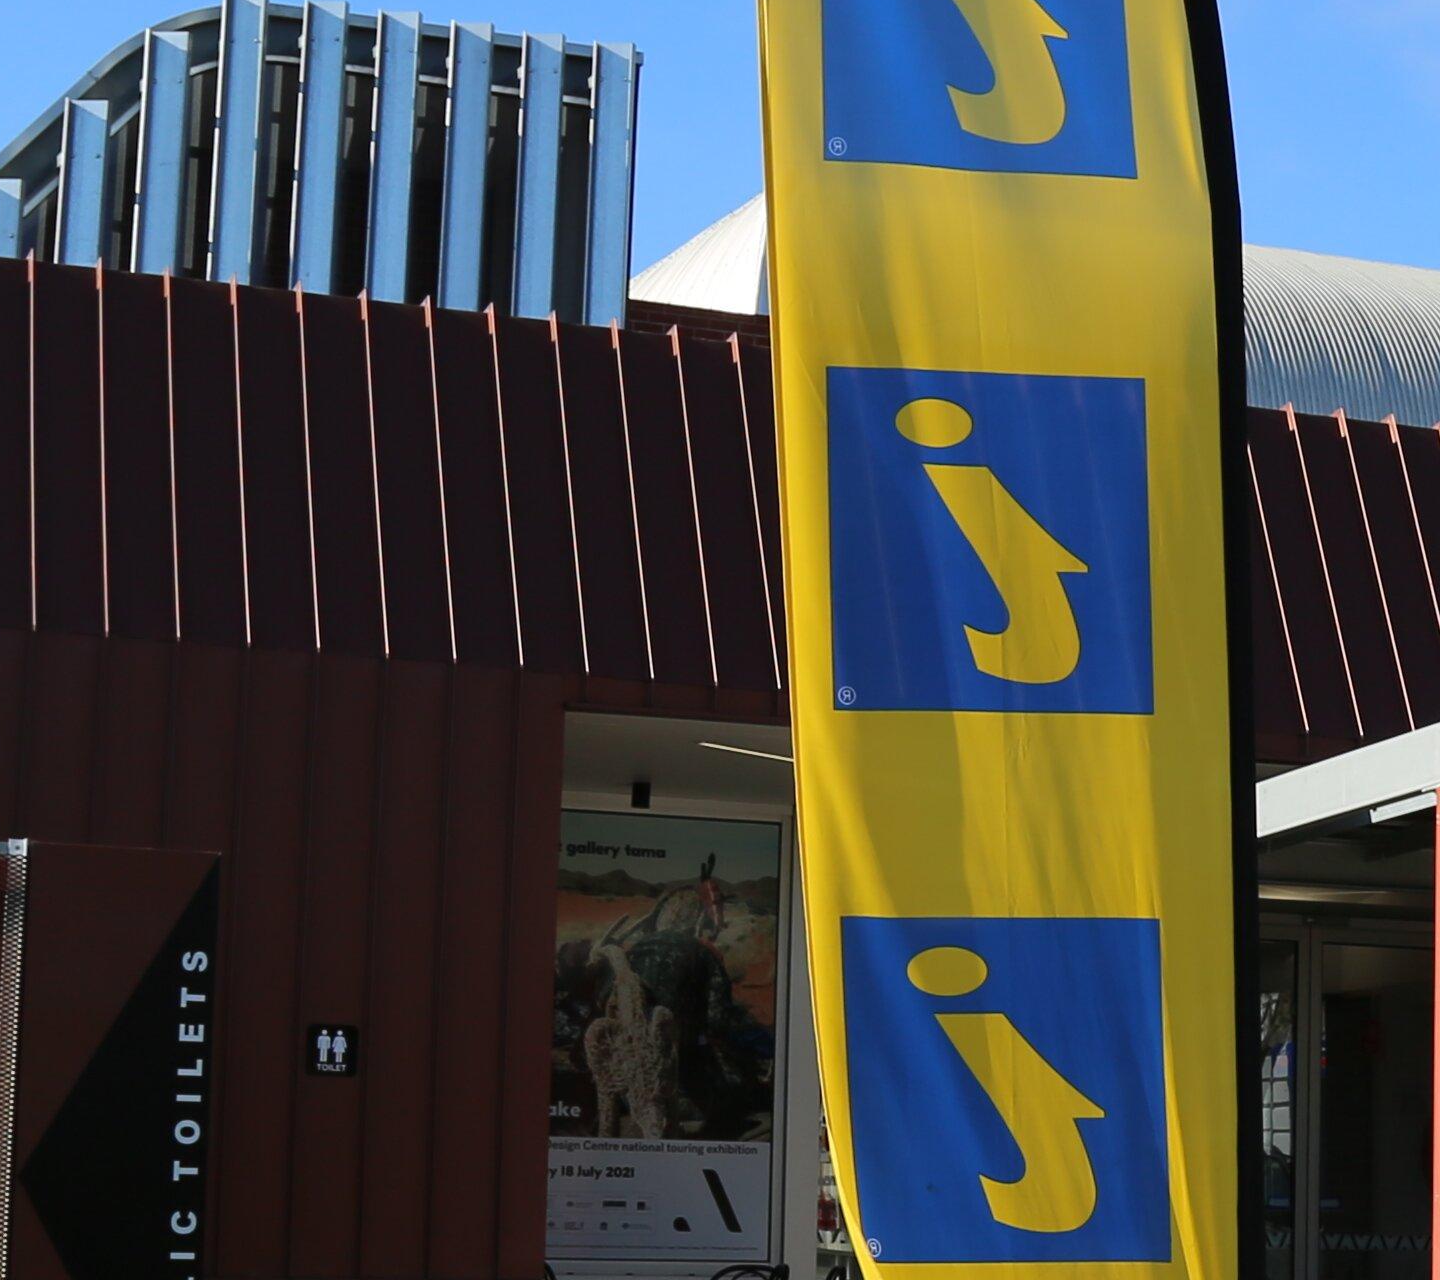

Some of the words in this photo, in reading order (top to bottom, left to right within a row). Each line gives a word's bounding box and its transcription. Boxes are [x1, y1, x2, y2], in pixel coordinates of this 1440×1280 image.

[566, 840, 620, 859] gallery
[624, 844, 667, 858] tama
[173, 951, 208, 1181] TOILETS
[316, 1063, 347, 1072] TOILET
[548, 1100, 582, 1118] ake
[583, 1140, 619, 1151] Centre
[622, 1143, 664, 1153] national
[667, 1144, 704, 1155] touring
[707, 1145, 758, 1155] exhibition
[577, 1166, 602, 1180] July
[605, 1167, 635, 1178] 2021
